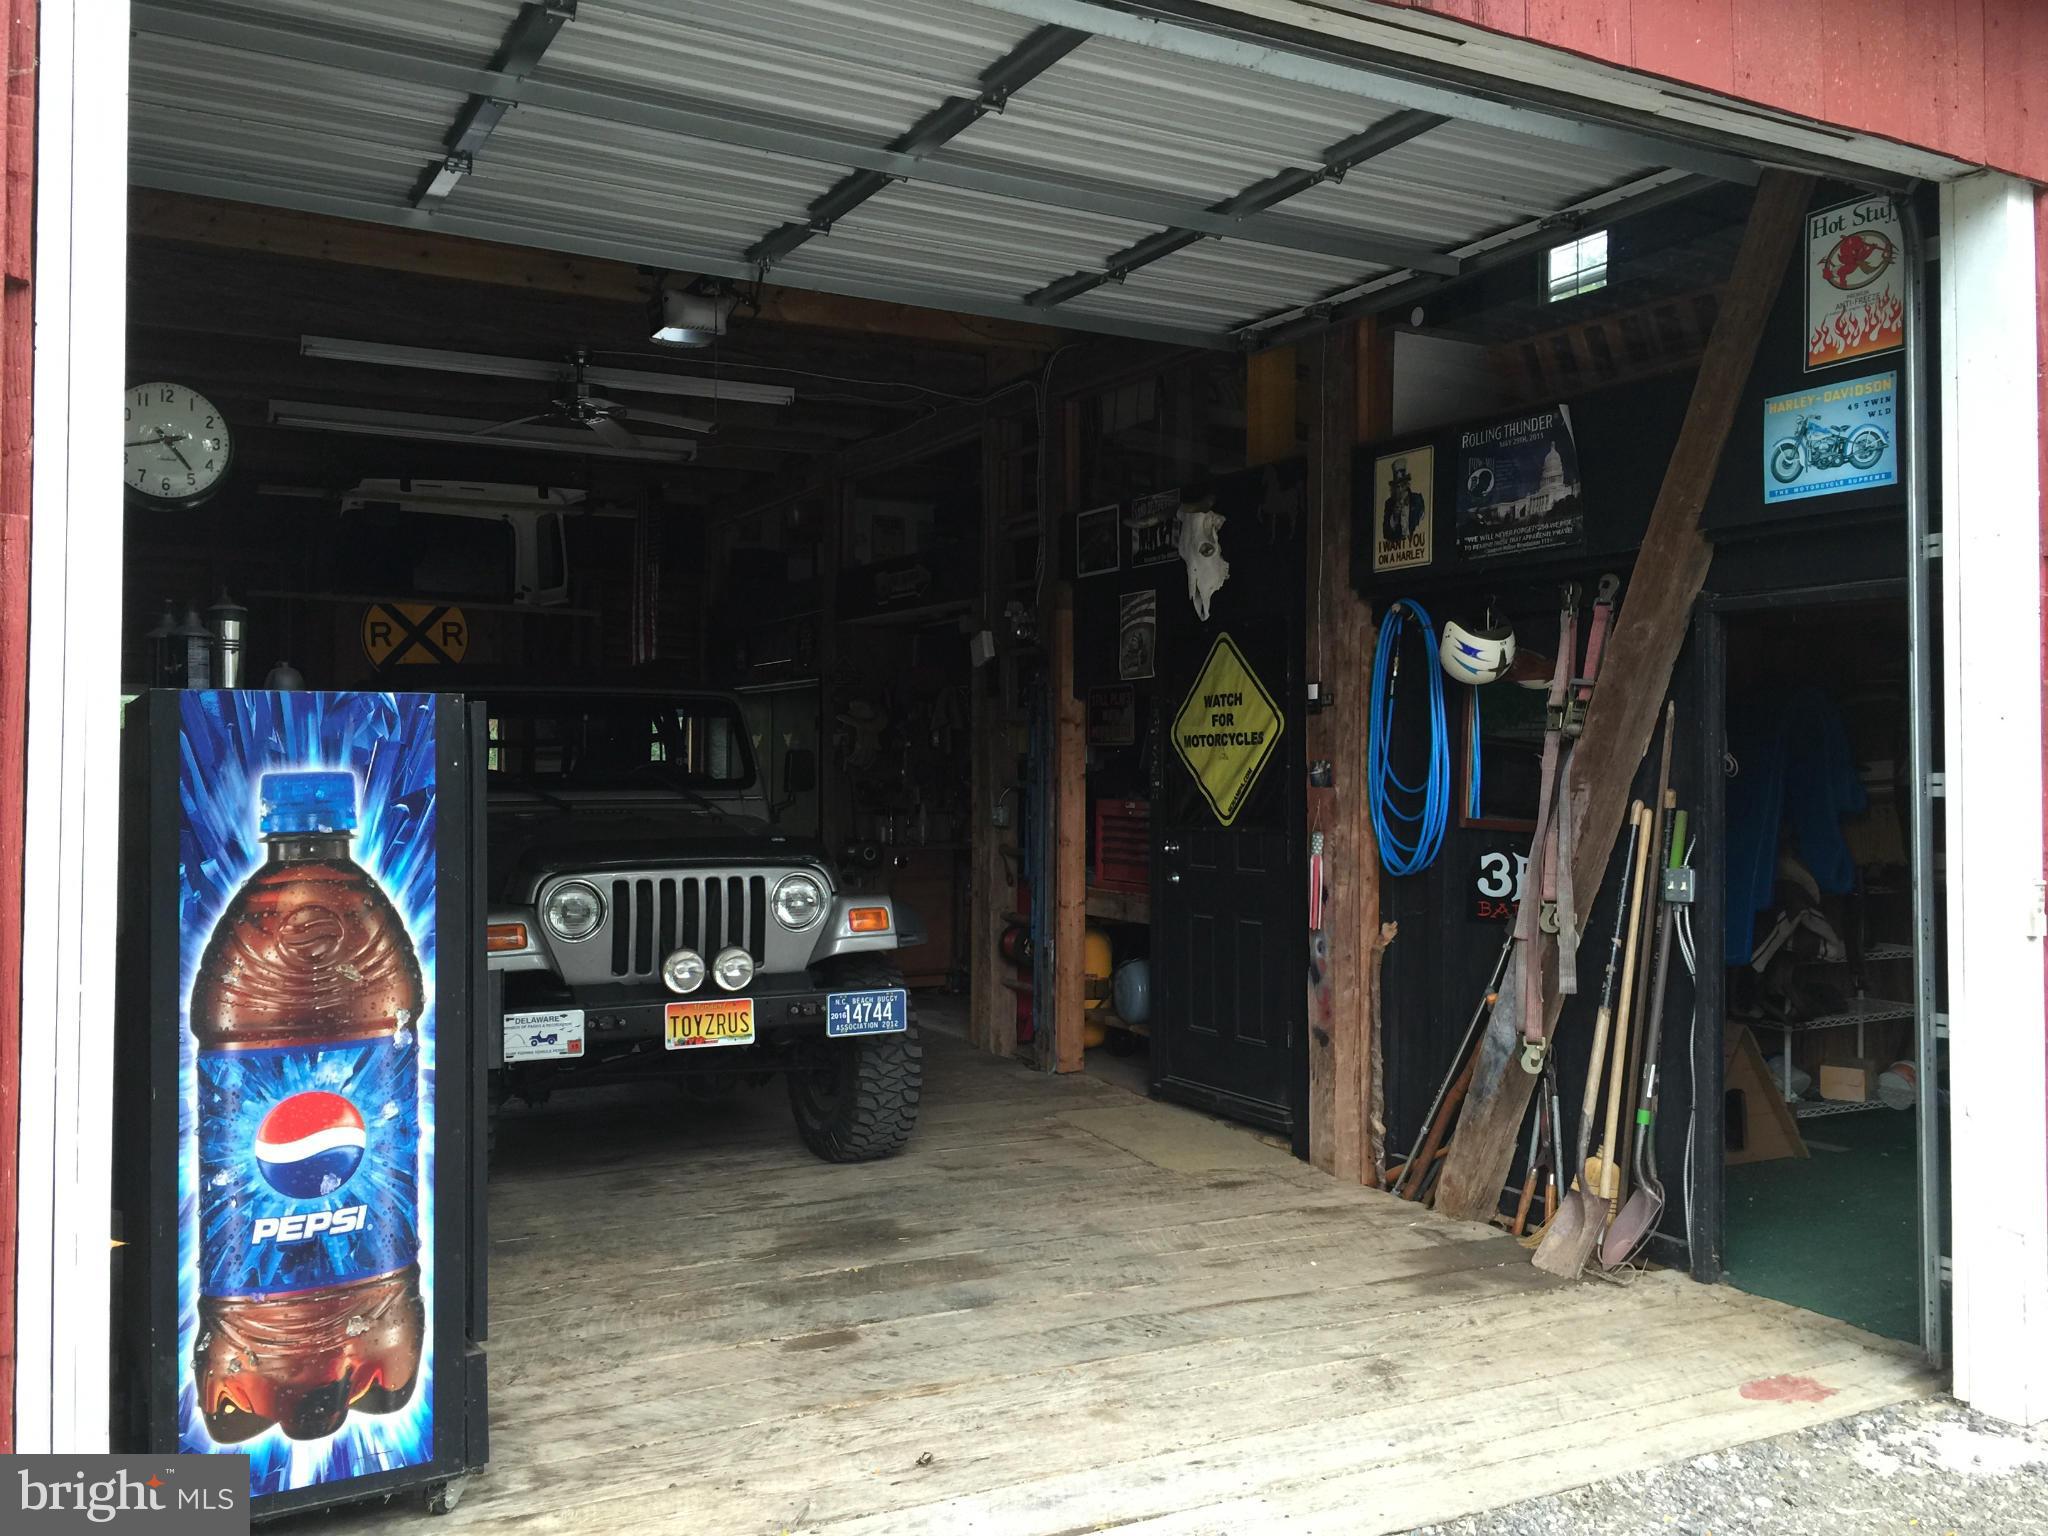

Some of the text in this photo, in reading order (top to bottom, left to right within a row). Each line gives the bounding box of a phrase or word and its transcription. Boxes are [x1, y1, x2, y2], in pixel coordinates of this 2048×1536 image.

[1813, 216, 1847, 239] Hot
[138, 392, 149, 407] 11
[160, 389, 174, 403] 12
[1769, 380, 1892, 413] HARLEY-DAVIDSON
[1864, 396, 1891, 407] TWIN
[189, 398, 193, 411] 1
[1868, 408, 1891, 418] WLD
[205, 416, 214, 428] 2
[1462, 414, 1553, 449] ROLLING THUNDER
[212, 438, 220, 451] 3
[205, 459, 214, 472] 4
[138, 469, 146, 483] 7
[187, 473, 196, 486] 5
[161, 477, 171, 491] 6
[1794, 481, 1844, 493] MOTORCYCLE
[1848, 474, 1887, 484] SUPREME
[1378, 532, 1425, 554] I WANT YOU
[1378, 548, 1424, 565] ON A HARLEY
[1204, 692, 1243, 708] WATCH
[1211, 713, 1234, 727] FOR
[1183, 731, 1264, 749] MOTORCYCLES
[851, 996, 874, 1005] BEACH
[877, 995, 898, 1003] BUGGY
[830, 1012, 847, 1020] 2016
[844, 1001, 892, 1024] 14744
[515, 1015, 560, 1025] DELAWARE
[669, 1011, 749, 1038] TOYZRUS
[836, 1020, 899, 1031] ASSOCIATION 2012
[252, 1204, 368, 1244] PEPSI
